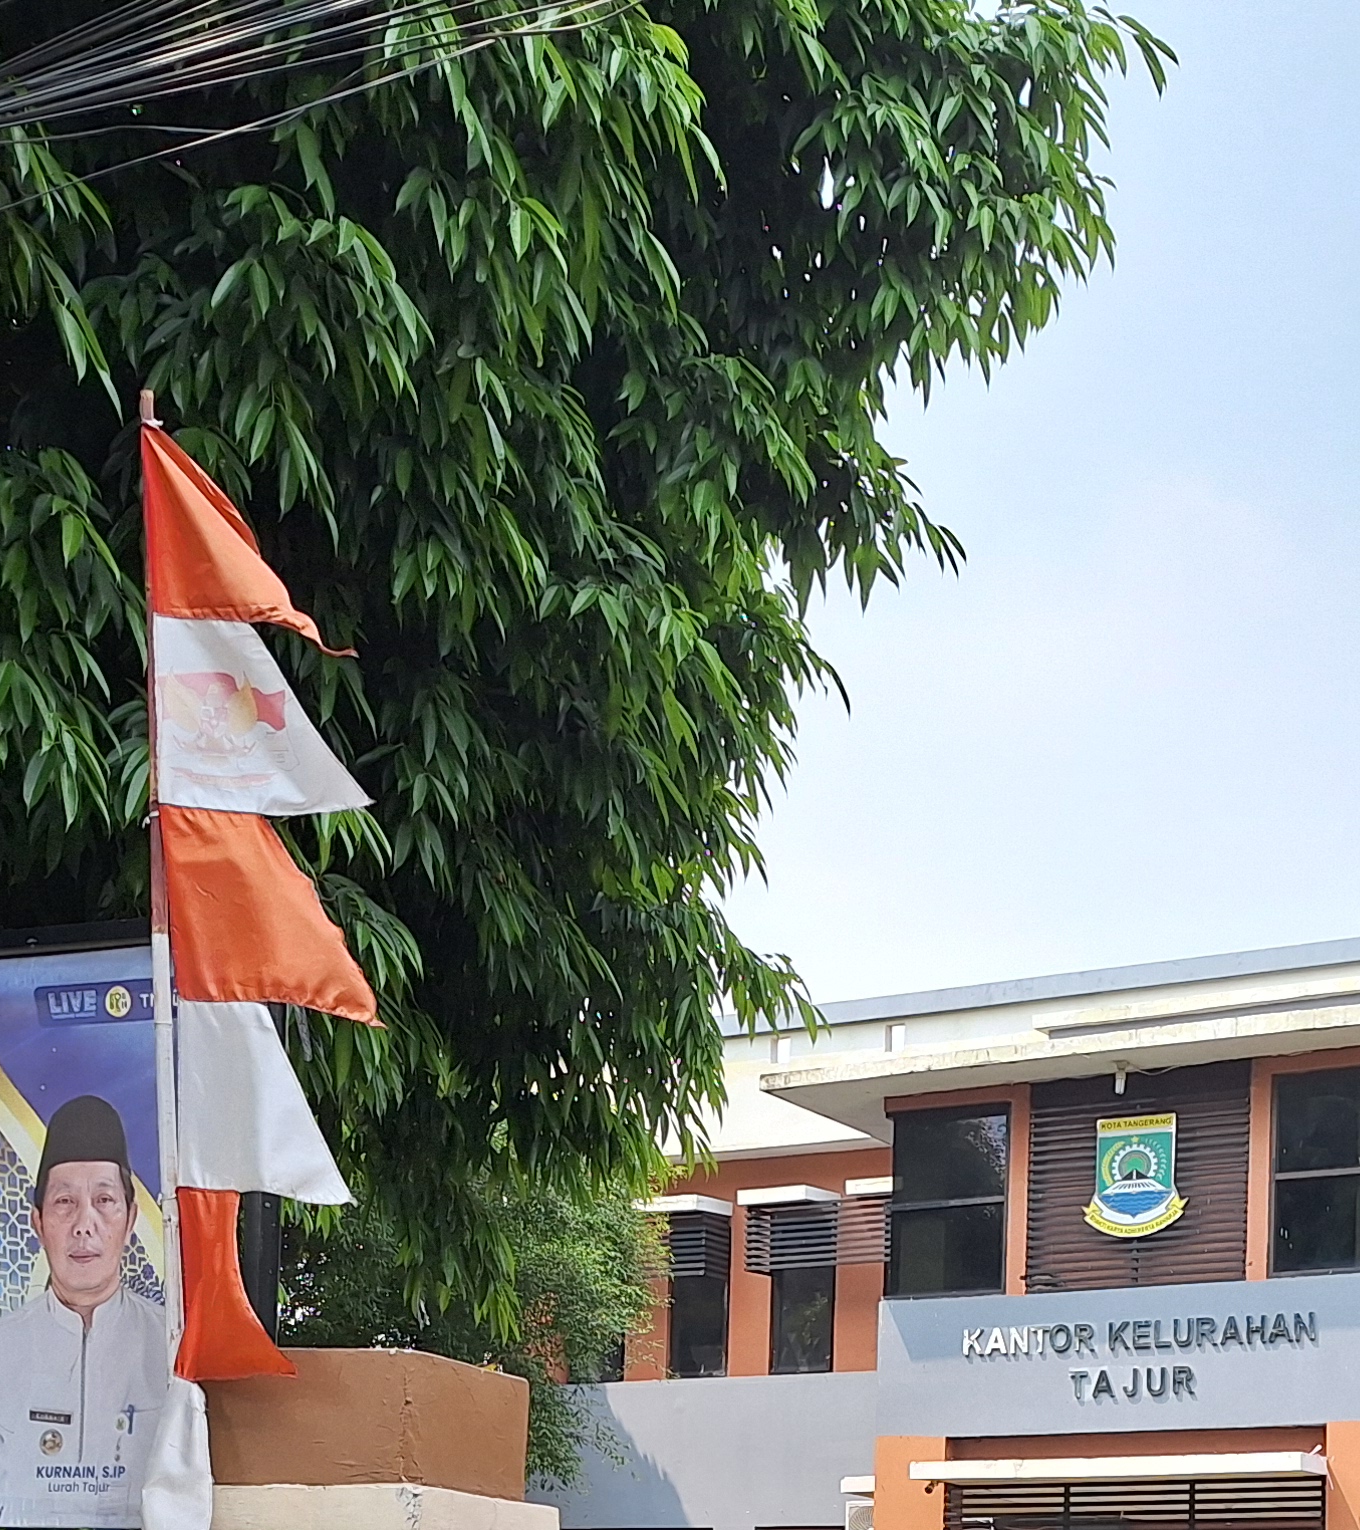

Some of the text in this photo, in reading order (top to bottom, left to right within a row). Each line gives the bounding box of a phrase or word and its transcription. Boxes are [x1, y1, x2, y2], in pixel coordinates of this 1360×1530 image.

[47, 989, 97, 1014] LIVE
[1101, 1117, 1172, 1131] KOTA TANGERANG
[962, 1312, 1317, 1357] KANTOR KELURAHAN
[1069, 1366, 1196, 1400] TAJUR
[36, 1466, 126, 1481] KURNAIN, S.IP
[48, 1482, 110, 1495] Lurah Tajur
